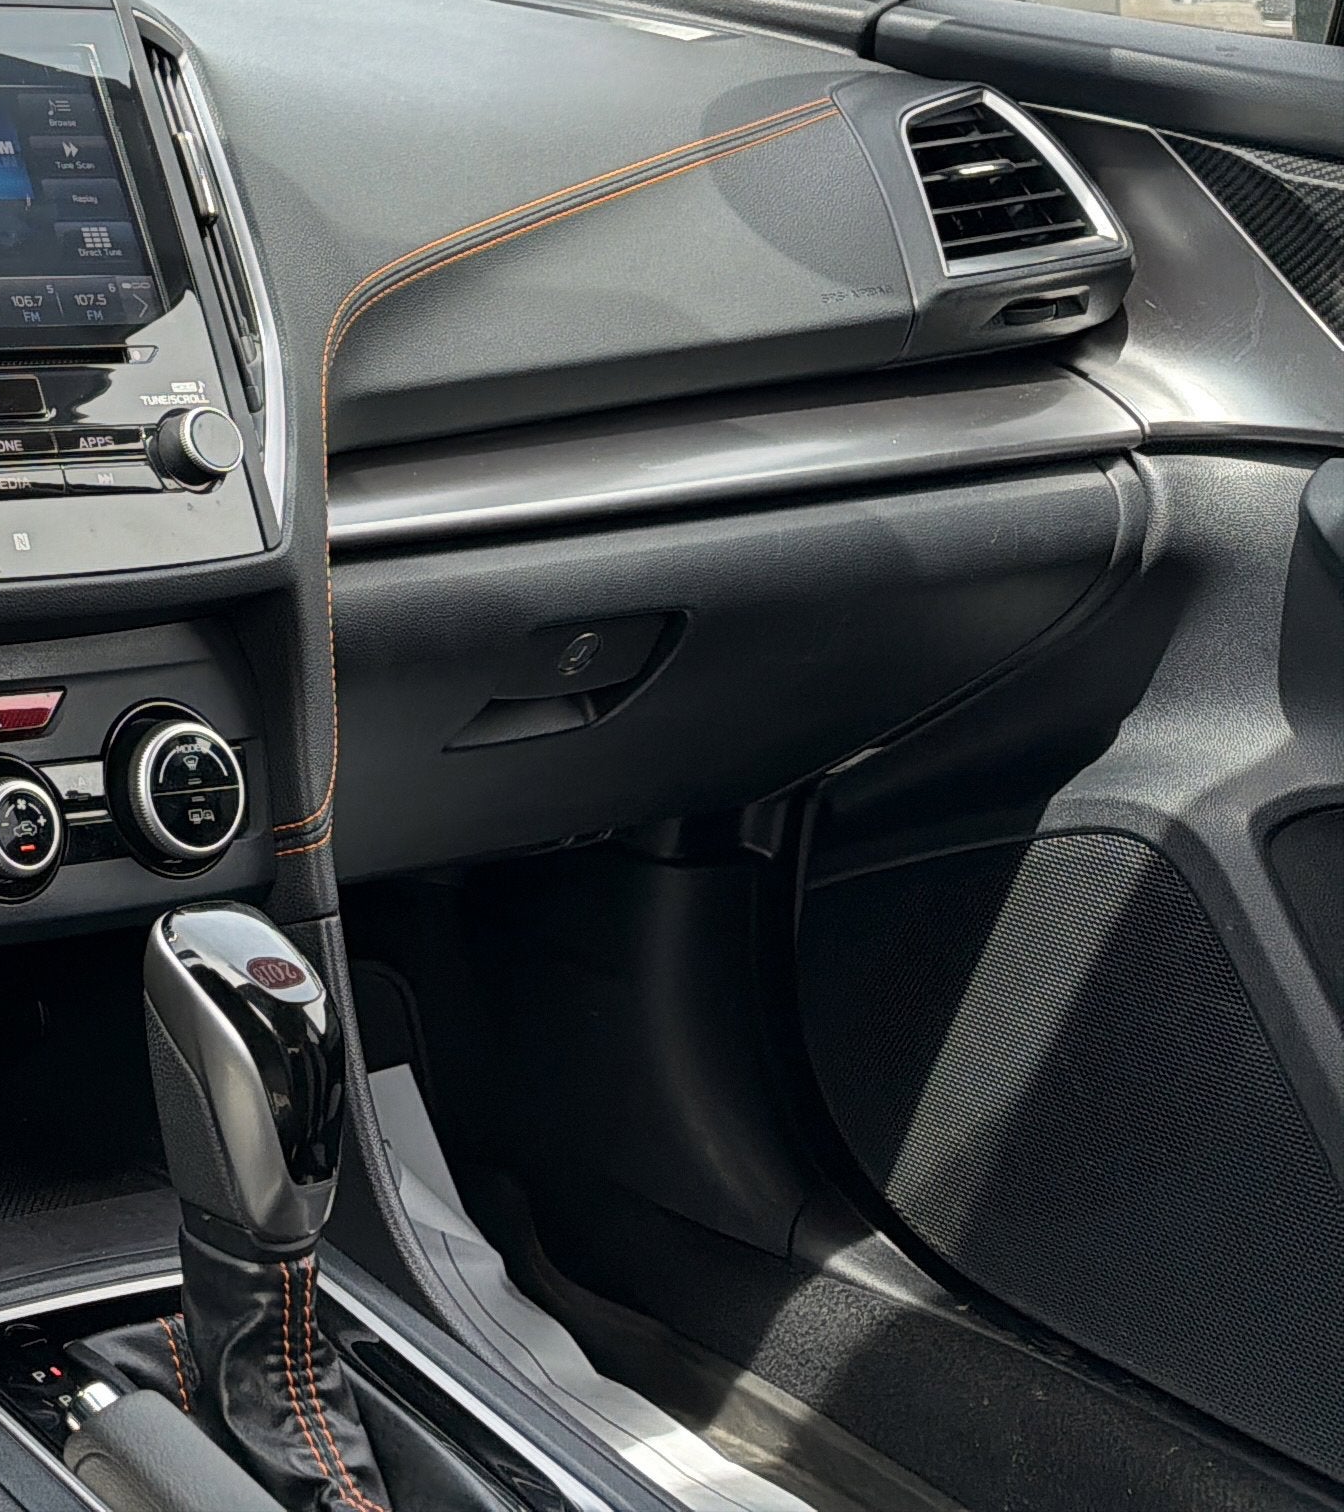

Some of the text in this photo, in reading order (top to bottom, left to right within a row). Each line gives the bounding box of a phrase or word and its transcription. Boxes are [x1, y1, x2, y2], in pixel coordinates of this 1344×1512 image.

[10, 295, 44, 308] 106.7
[73, 293, 107, 306] 107.5
[23, 310, 41, 323] FM
[86, 309, 104, 322] FM
[78, 435, 115, 448] APPS
